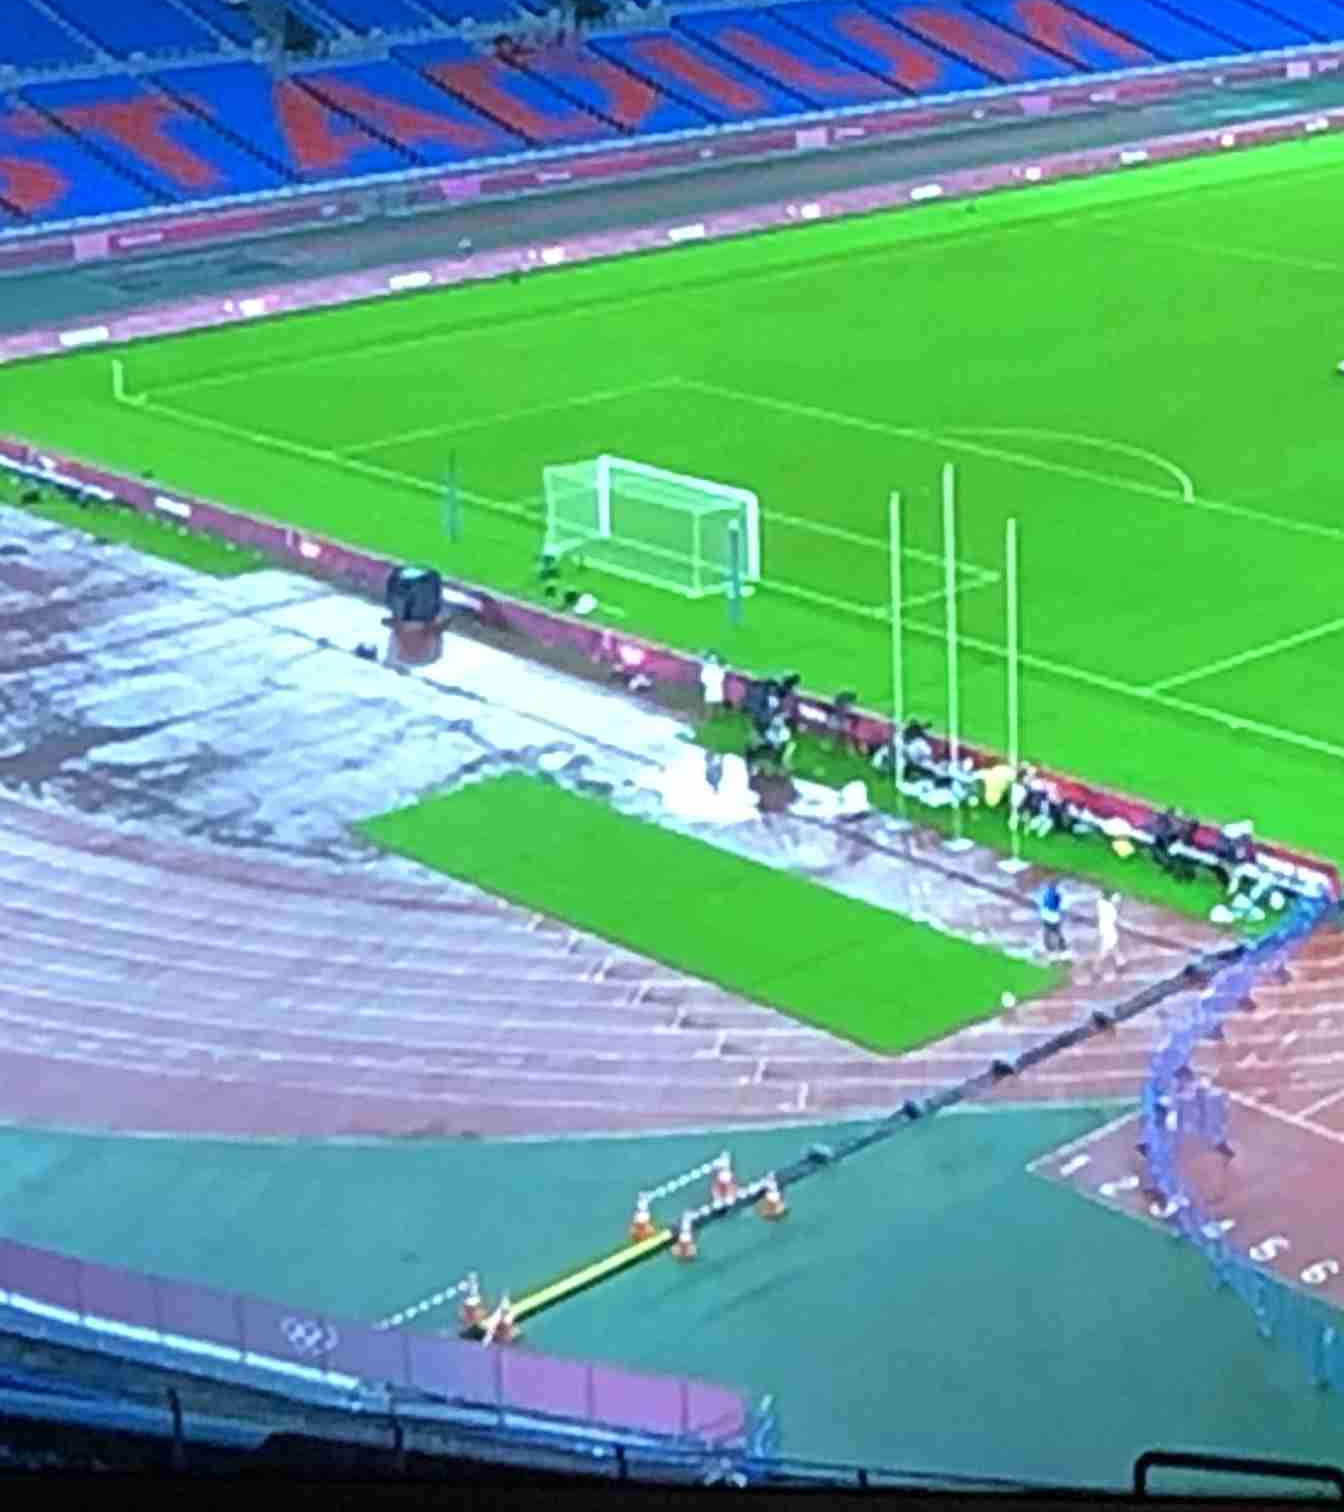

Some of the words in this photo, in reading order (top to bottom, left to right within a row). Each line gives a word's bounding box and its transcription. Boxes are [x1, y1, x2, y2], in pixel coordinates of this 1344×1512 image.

[1060, 1154, 1091, 1176] 1
[1249, 1236, 1290, 1262] 5
[1300, 1259, 1340, 1285] 6
